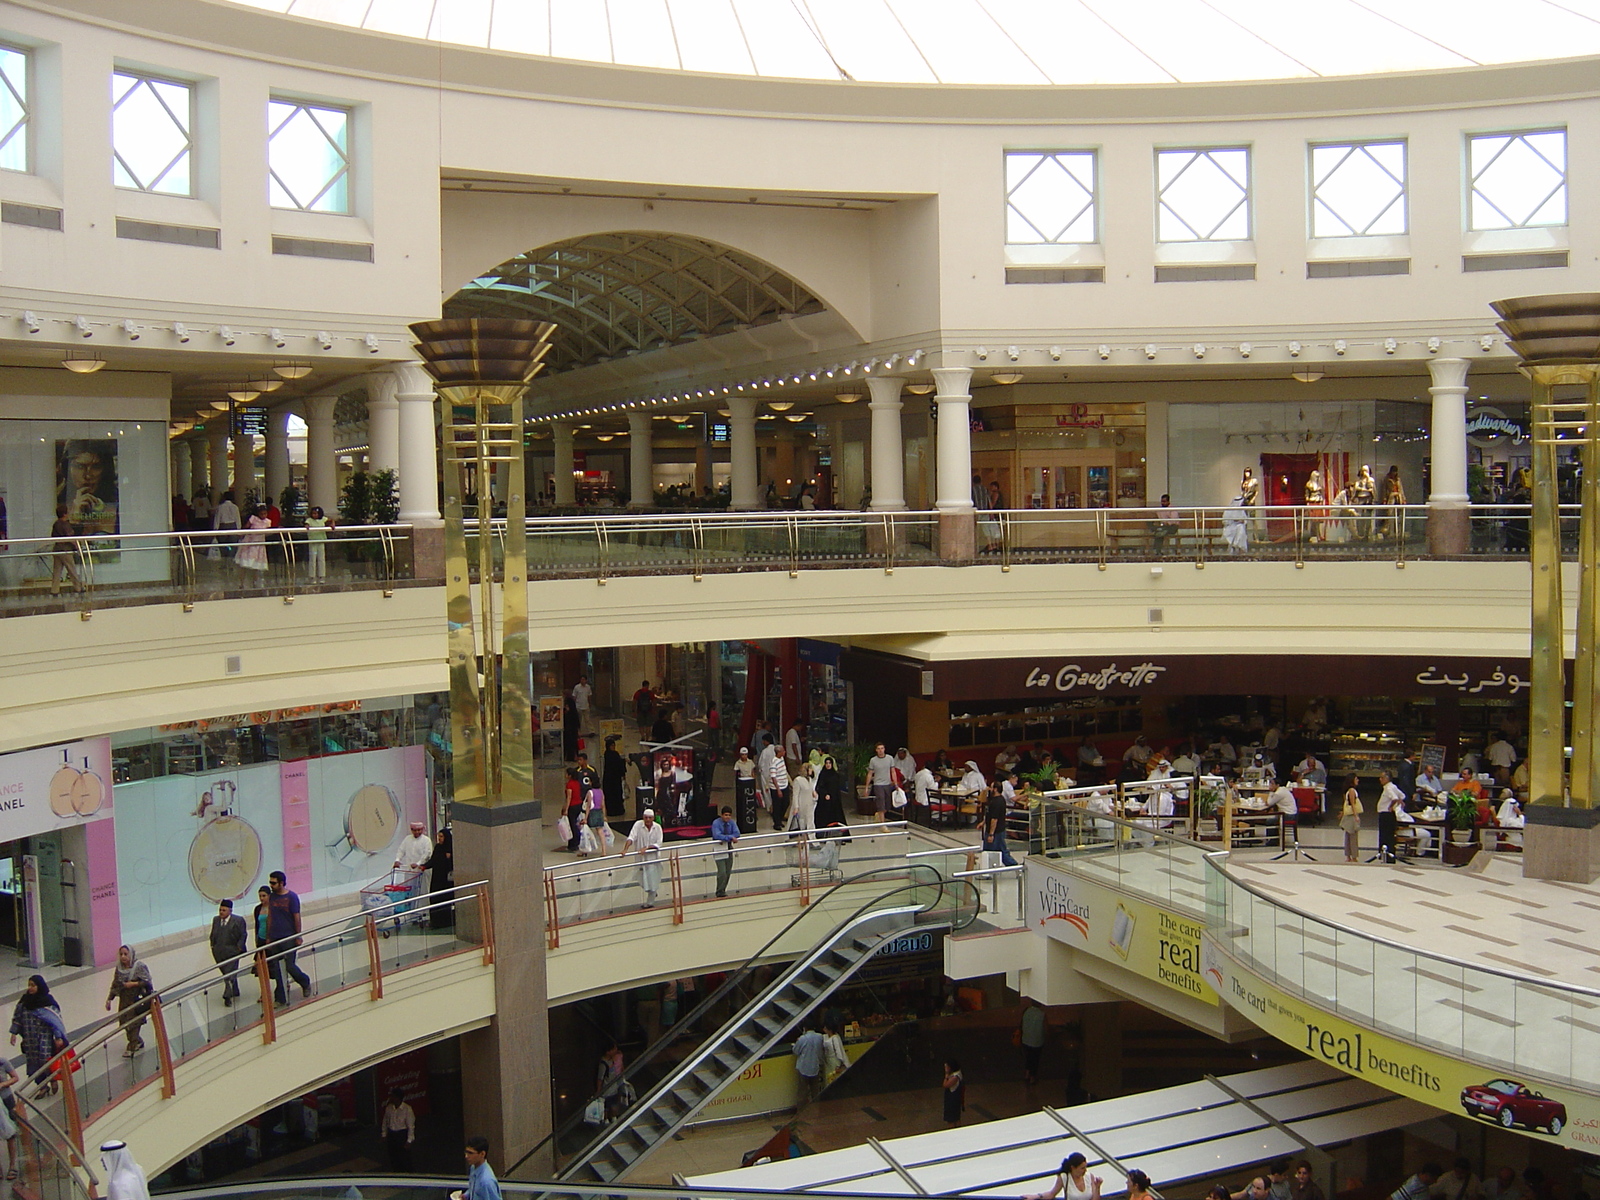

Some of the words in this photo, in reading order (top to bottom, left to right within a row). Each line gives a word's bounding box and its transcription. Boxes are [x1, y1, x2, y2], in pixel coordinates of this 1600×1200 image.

[1025, 666, 1051, 688] La
[1055, 662, 1167, 692] Gaufrette
[215, 858, 238, 867] CHANEL
[91, 881, 115, 893] CHANCE
[92, 890, 116, 901] CHANEL
[1046, 876, 1069, 902] City
[1039, 890, 1067, 920] Win
[1066, 898, 1090, 920] Card
[1158, 912, 1177, 931] The
[1179, 923, 1201, 940] card
[1158, 927, 1169, 936] that
[1169, 932, 1182, 942] gives
[1182, 936, 1193, 946] you
[1159, 939, 1200, 974] real
[1158, 963, 1202, 994] benefits
[1231, 976, 1246, 1000] The
[1247, 992, 1266, 1013] card
[1267, 998, 1278, 1010] that
[1278, 1005, 1293, 1019] gives
[1293, 1013, 1305, 1024] you
[1306, 1024, 1363, 1073] real
[1368, 1048, 1440, 1092] benefits
[1571, 1130, 1600, 1145] GRAN
